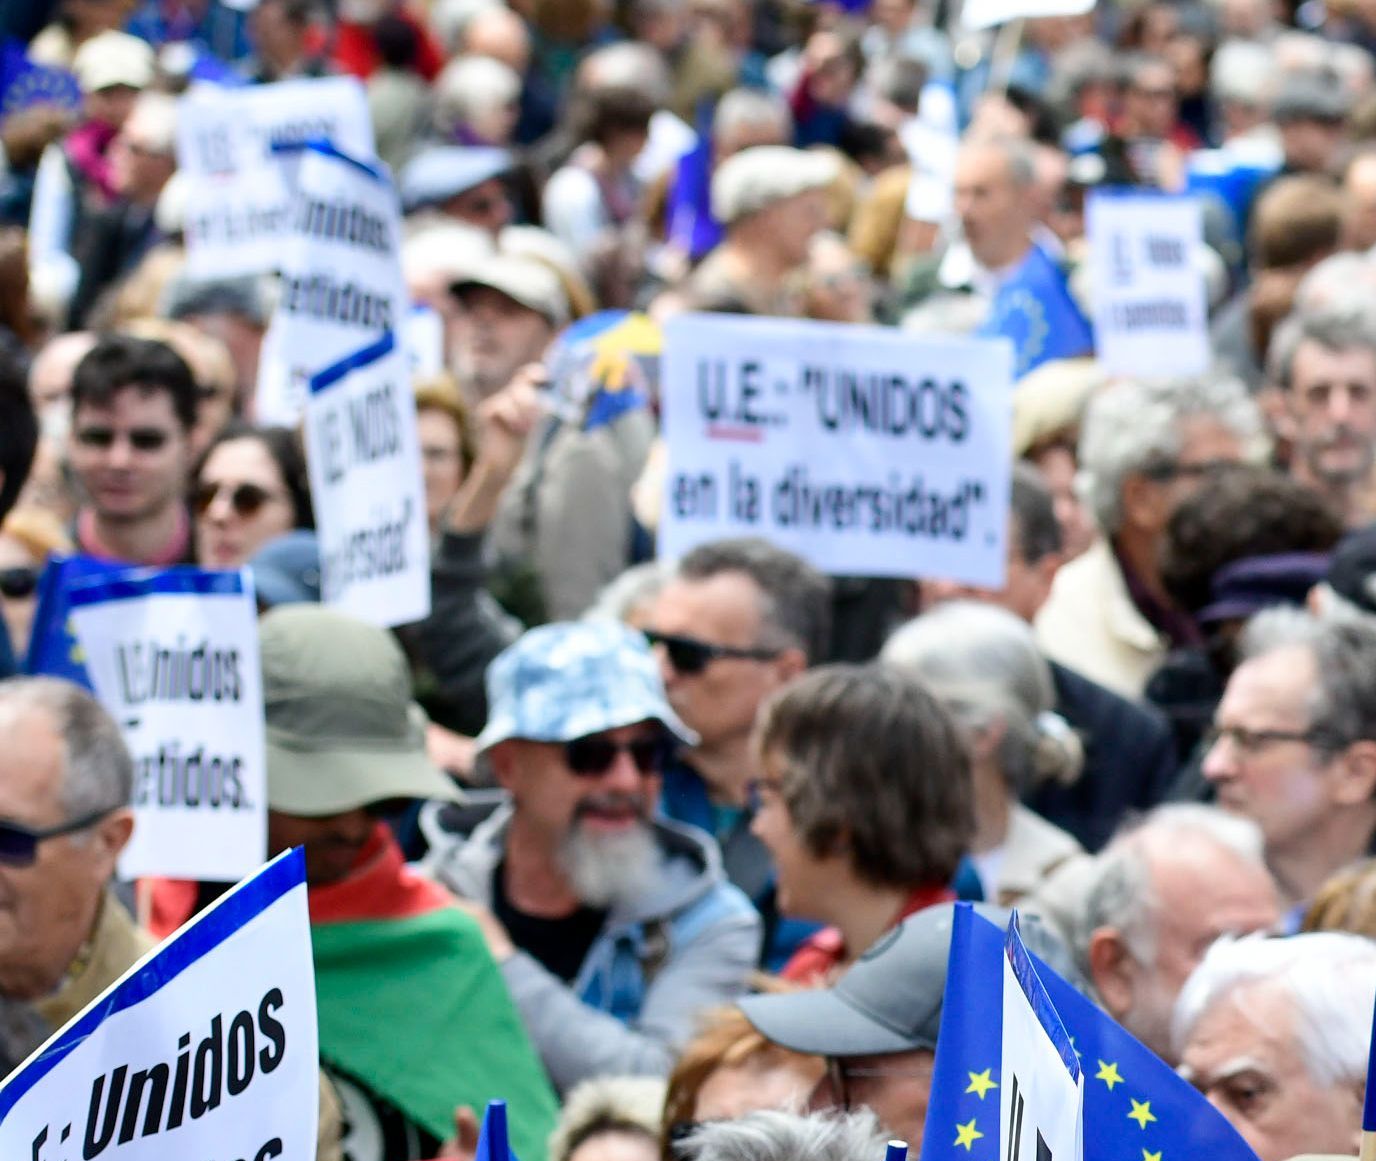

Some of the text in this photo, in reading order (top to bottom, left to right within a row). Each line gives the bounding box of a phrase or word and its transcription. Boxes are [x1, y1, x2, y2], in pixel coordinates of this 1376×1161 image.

[672, 472, 719, 518] en
[729, 457, 761, 524] la
[82, 987, 286, 1161] Unidos
